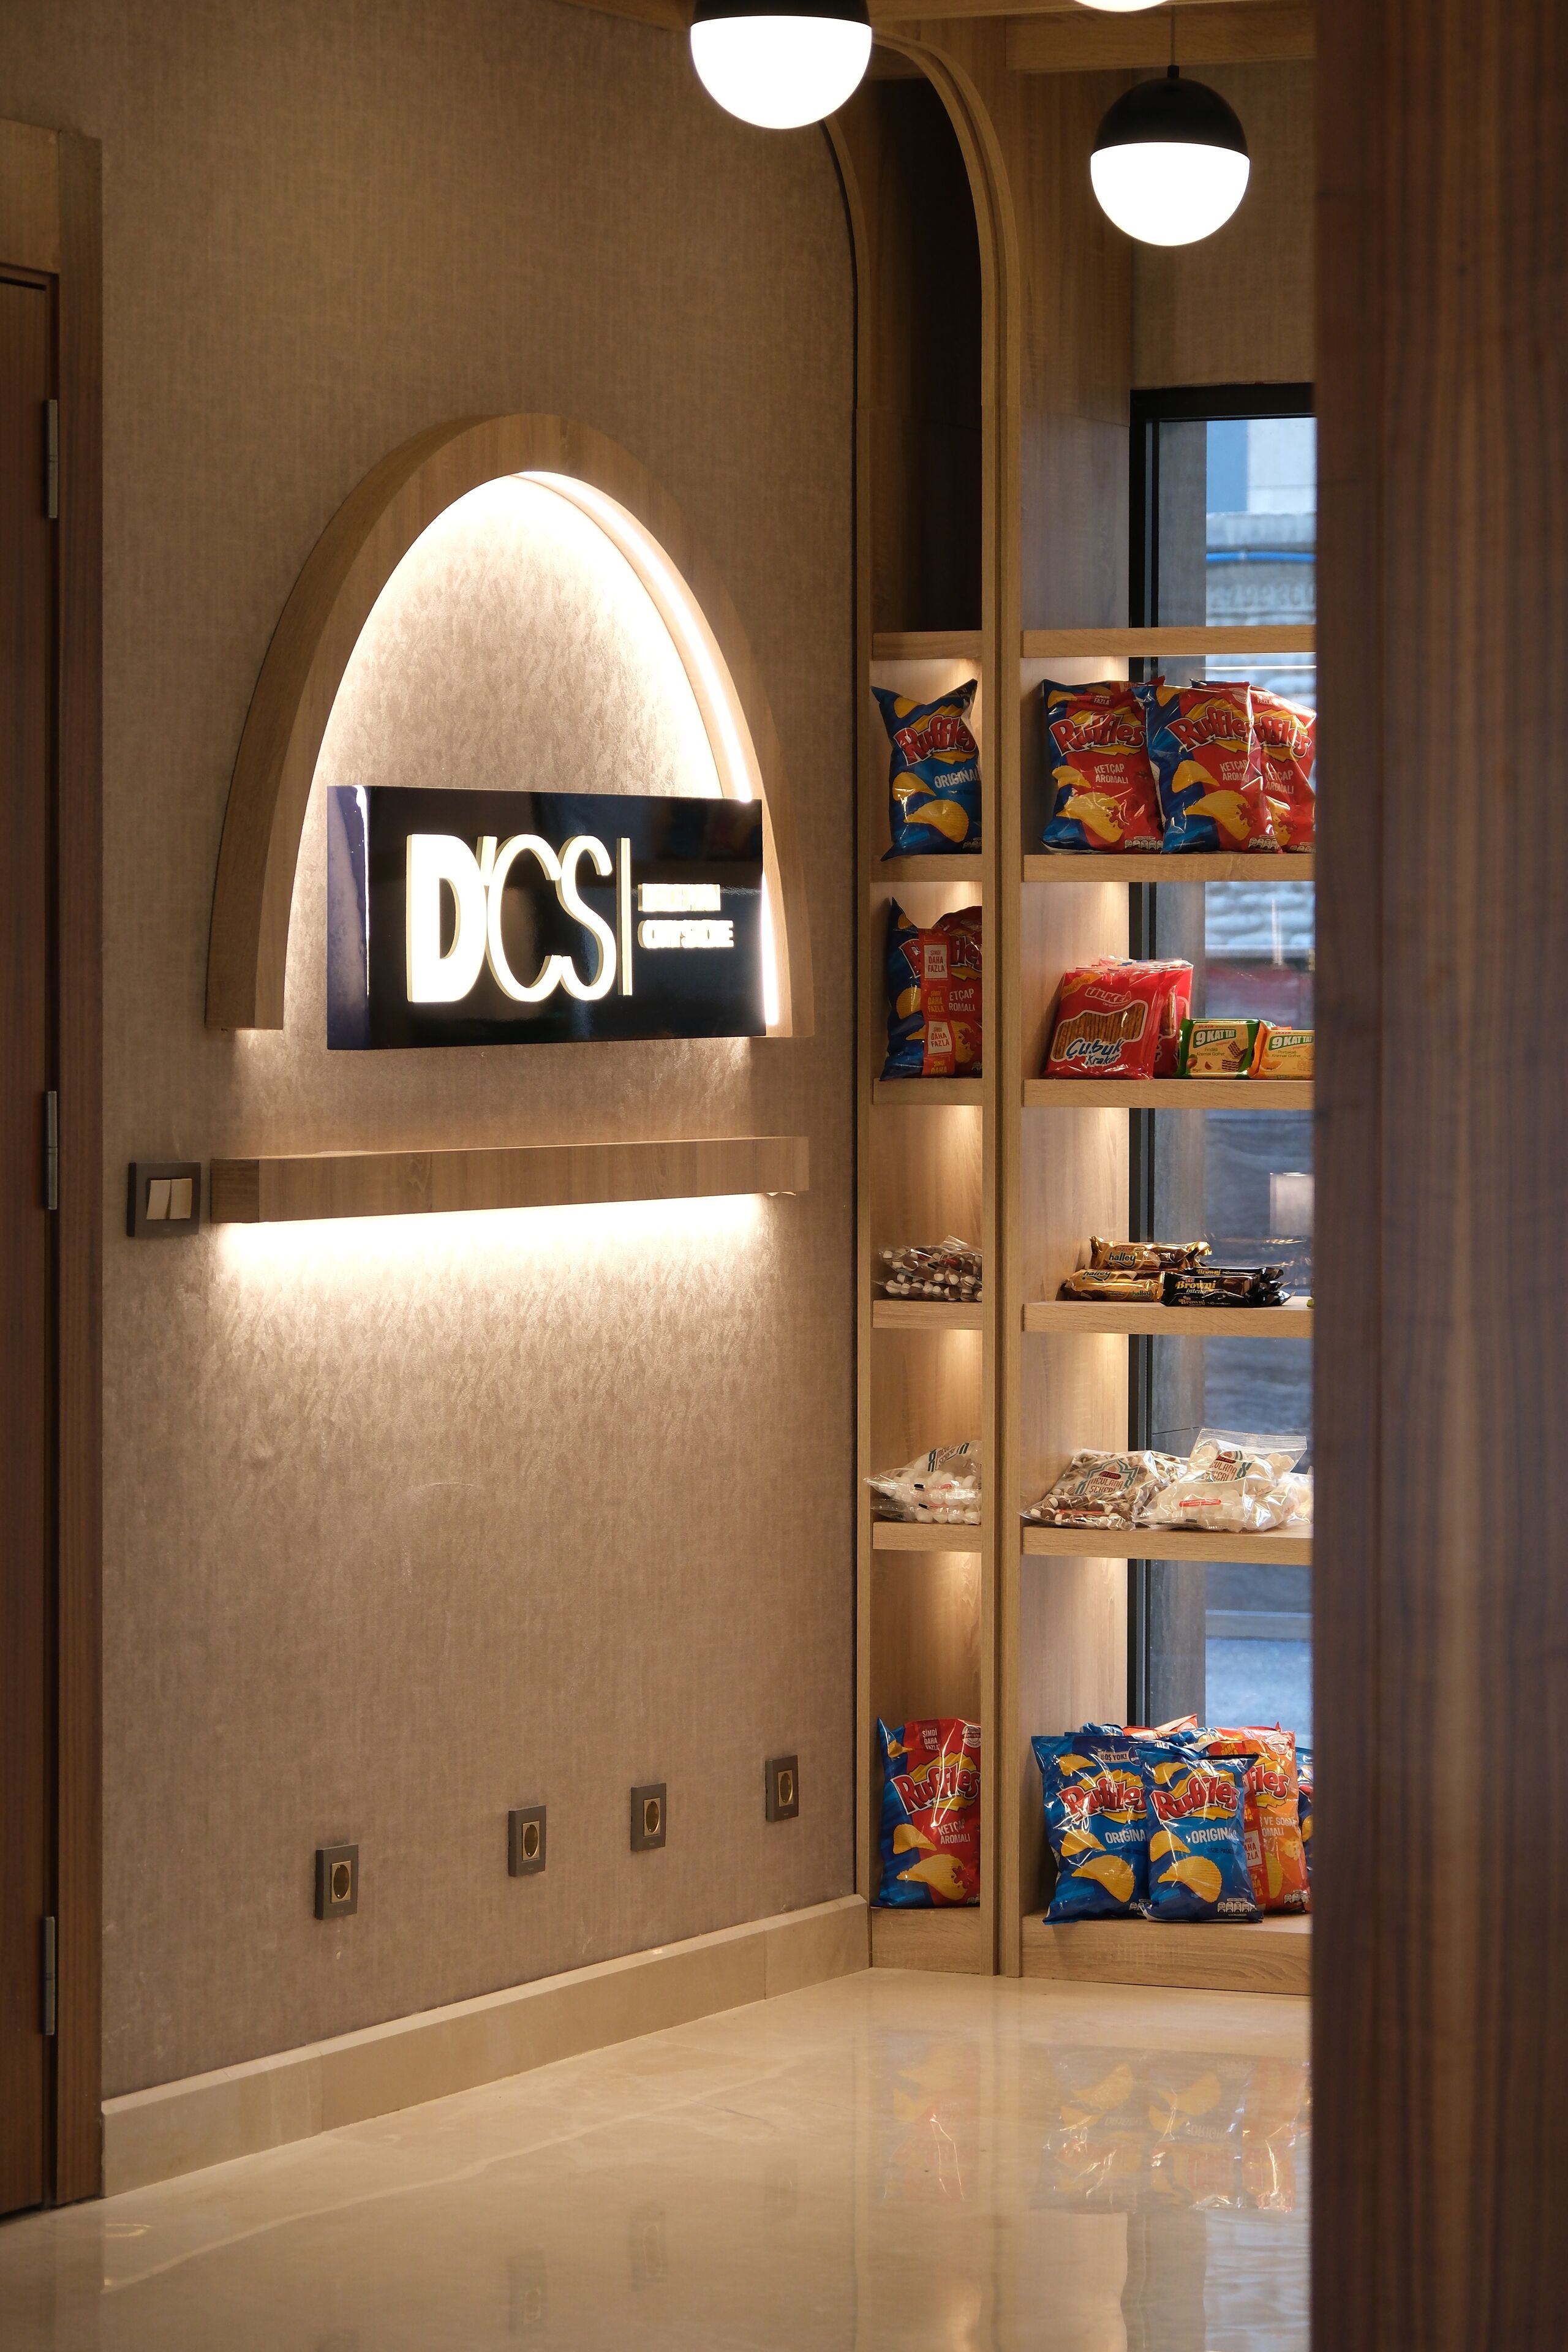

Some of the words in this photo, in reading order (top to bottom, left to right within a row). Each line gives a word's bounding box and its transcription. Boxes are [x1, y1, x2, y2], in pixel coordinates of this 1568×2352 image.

[1049, 712, 1147, 756] Ruffles
[1094, 763, 1125, 775] KETÇAP
[927, 997, 943, 1005] DAHA
[949, 989, 974, 1001] ETÇAP
[949, 1003, 976, 1012] ROMALI
[1196, 1031, 1206, 1046] 9
[1207, 1030, 1224, 1042] KAT
[1225, 1030, 1235, 1038] TAT
[1272, 1036, 1283, 1049] 9
[1283, 1036, 1302, 1046] KAT
[1066, 1038, 1124, 1059] Çubuk
[1109, 1252, 1136, 1266] halley
[1082, 1270, 1112, 1280] halley
[1175, 1280, 1216, 1290] Browni
[1132, 1289, 1151, 1298] halley
[890, 1763, 981, 1815] Ruffles
[1149, 1776, 1240, 1824] Ruffles
[1264, 1817, 1274, 1825] VE
[938, 1819, 965, 1836] KETÇAP
[1262, 1828, 1284, 1837] OMALI
[940, 1834, 971, 1845] AROMALI
[1105, 1829, 1147, 1844] ORIGINA
[1247, 1852, 1259, 1860] ZLA
